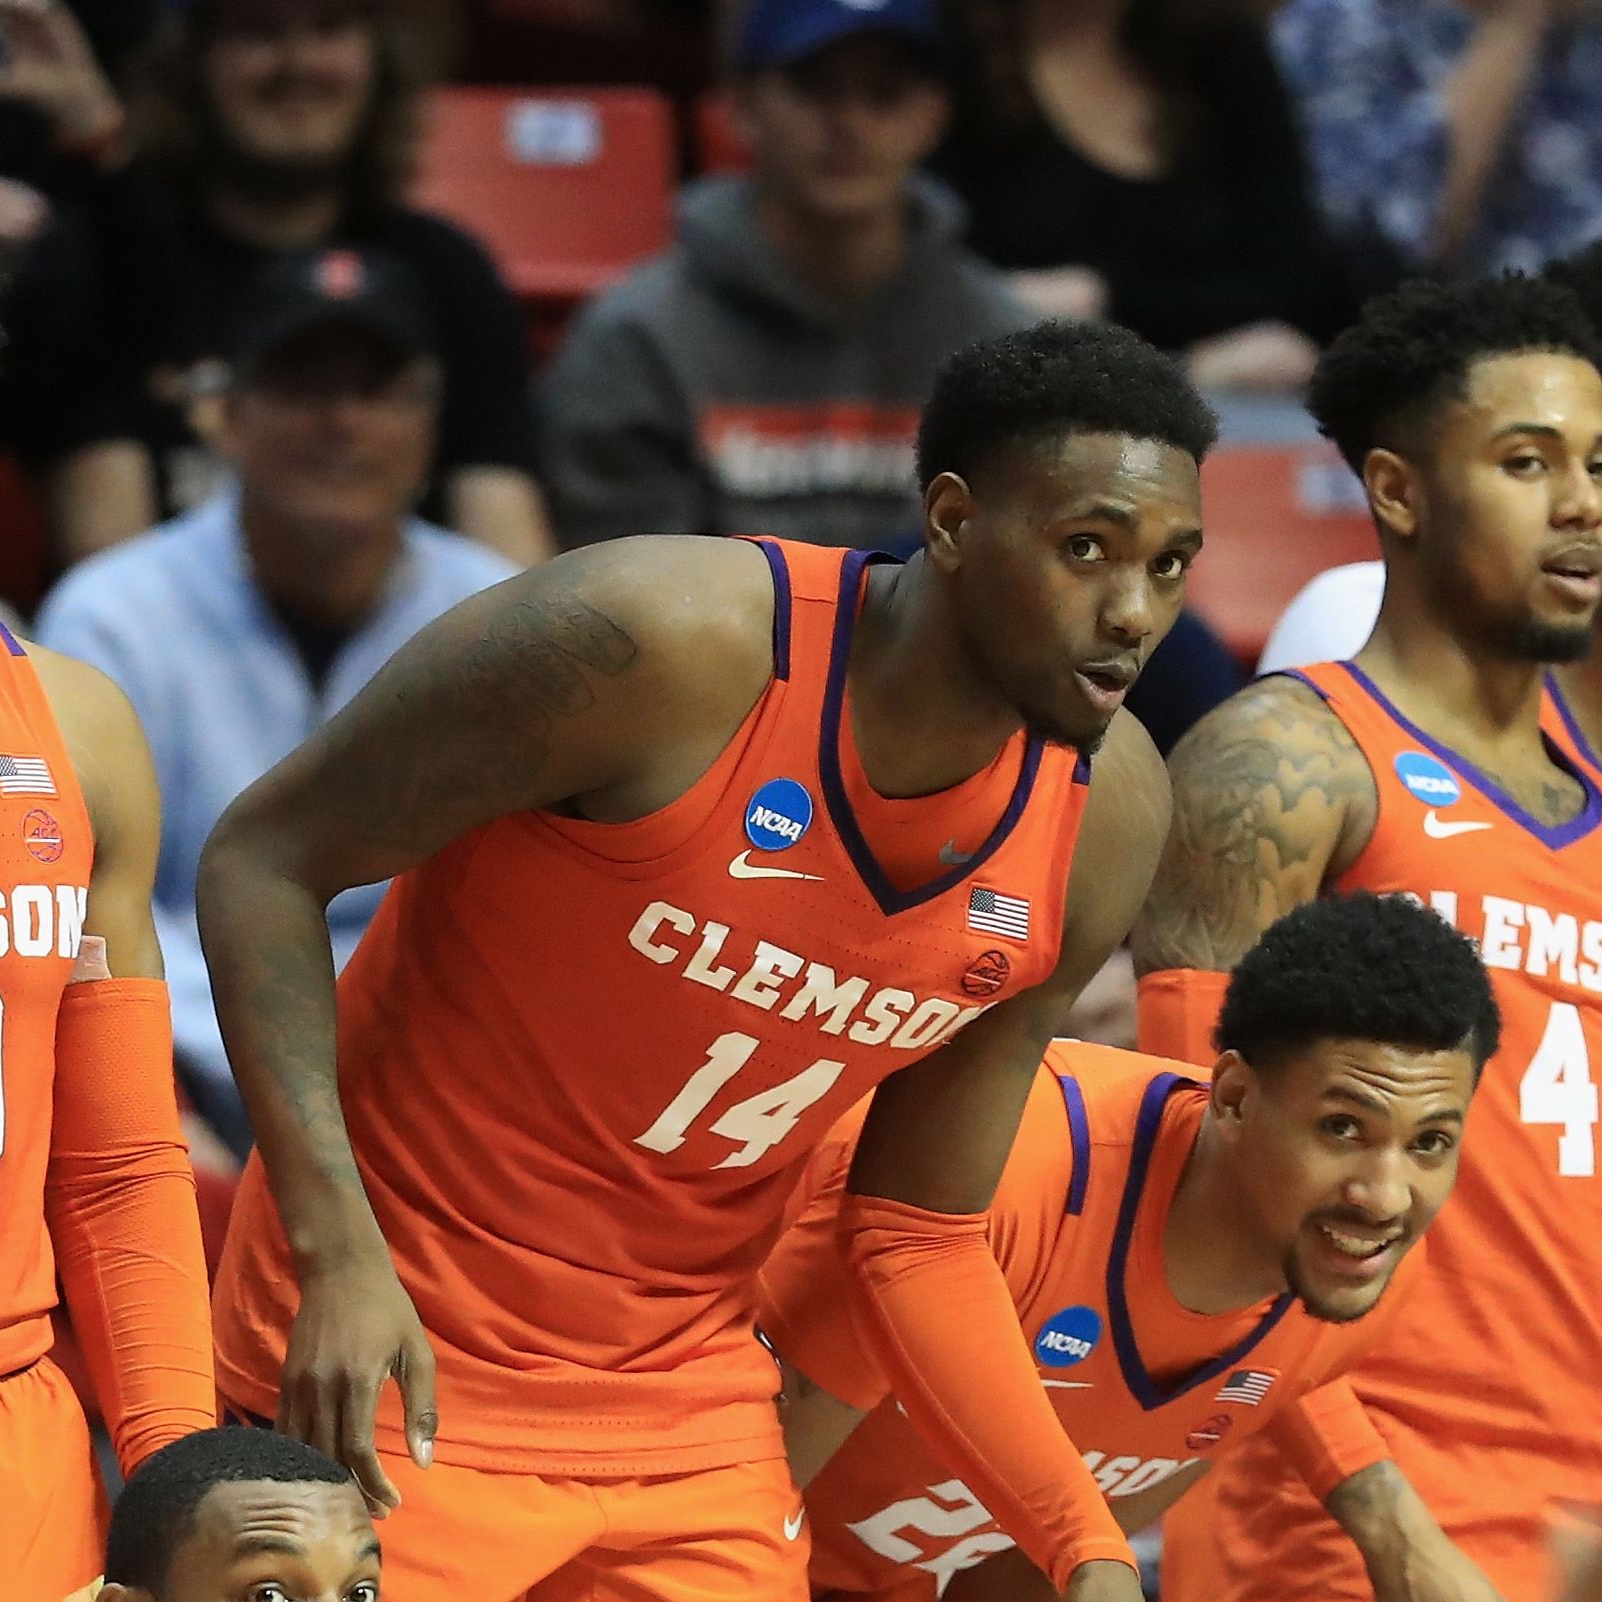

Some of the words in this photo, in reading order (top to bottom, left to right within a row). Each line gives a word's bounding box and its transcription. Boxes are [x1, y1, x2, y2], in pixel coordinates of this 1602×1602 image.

[750, 805, 805, 842] NCAA
[633, 1031, 846, 1170] 14
[1519, 1001, 1600, 1178] 4
[1040, 1330, 1093, 1359] NCAA
